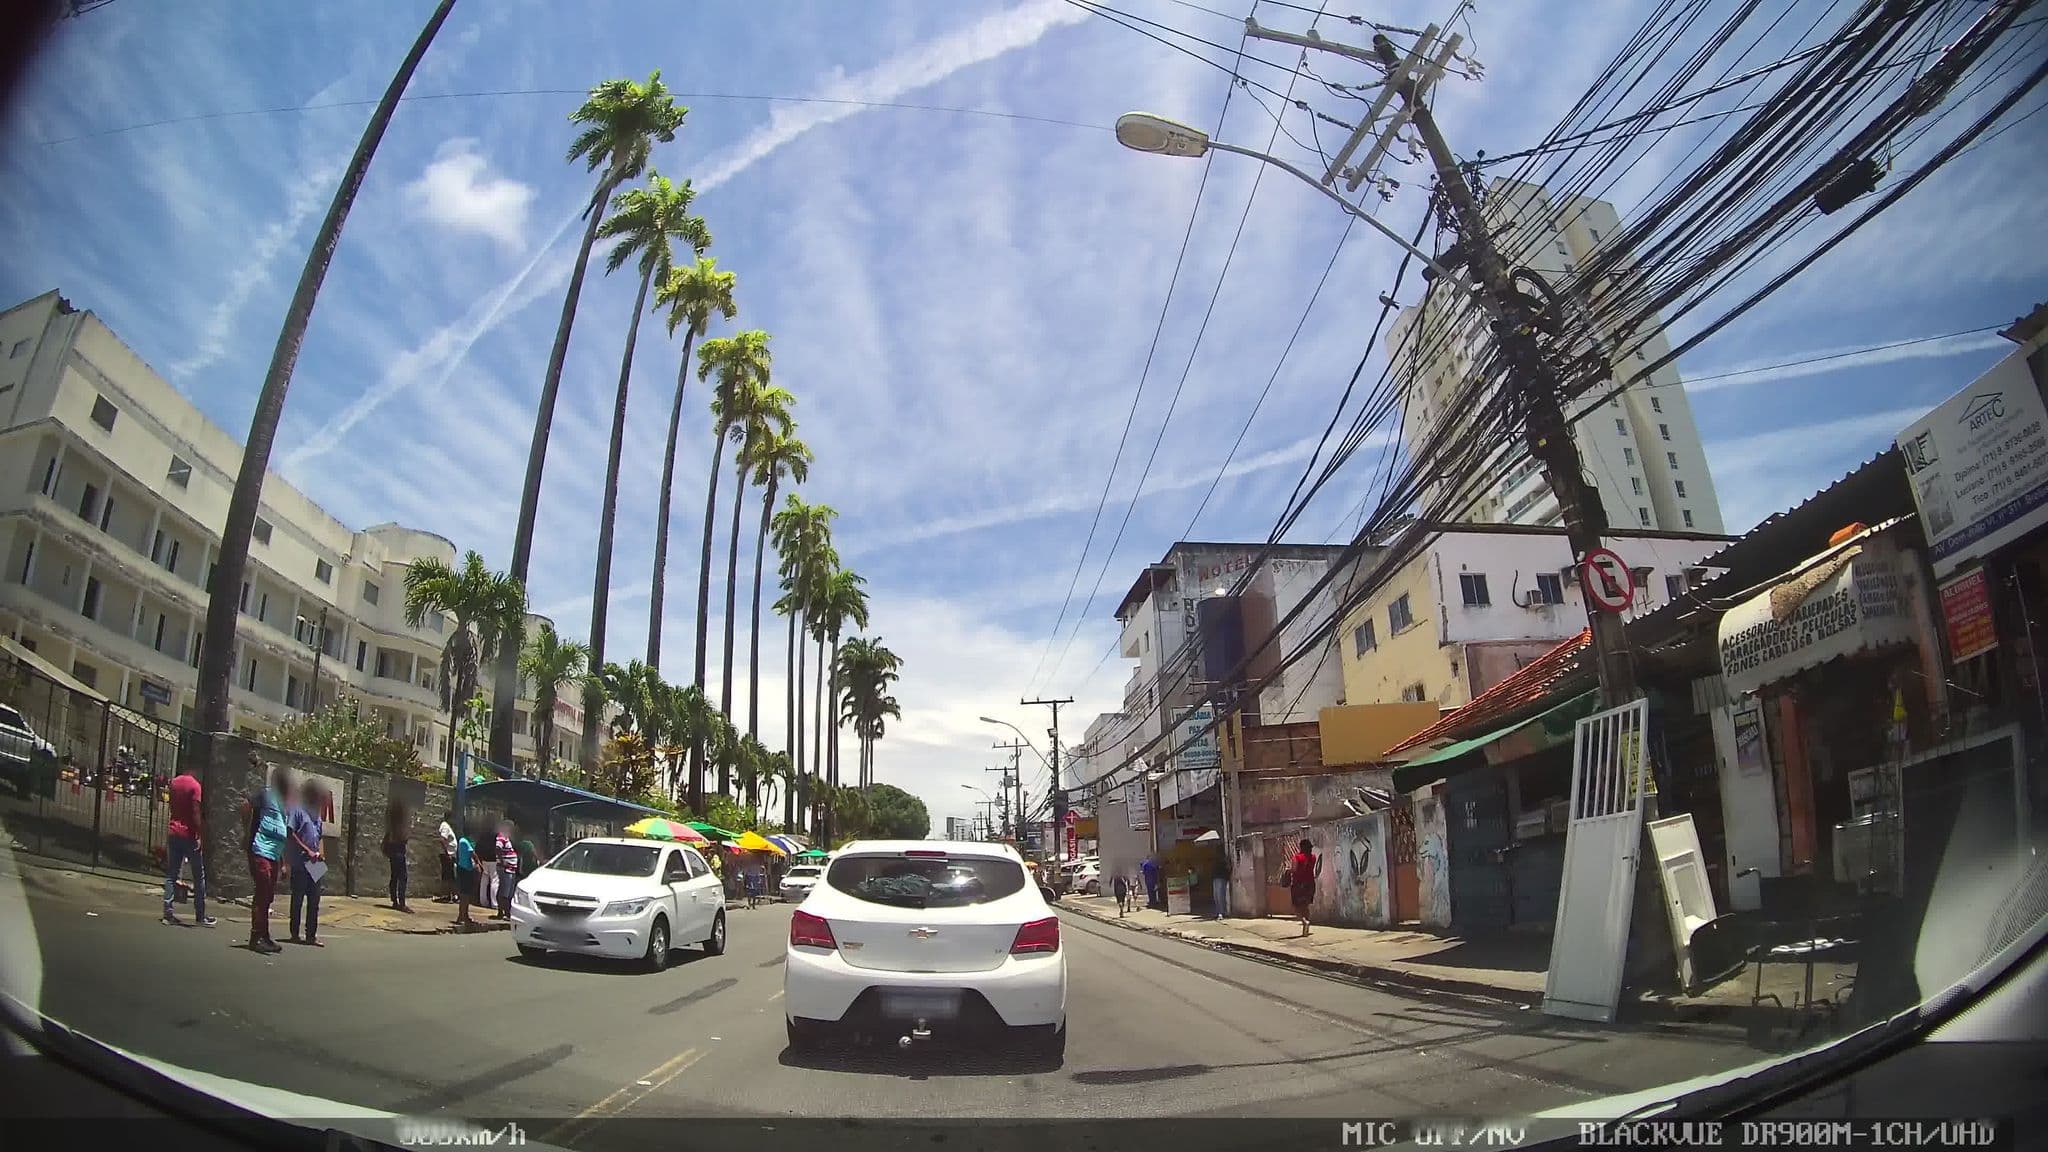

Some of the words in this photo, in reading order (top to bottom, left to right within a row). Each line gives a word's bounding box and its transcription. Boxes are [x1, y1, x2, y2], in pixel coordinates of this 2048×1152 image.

[1970, 399, 2005, 432] ARTEC
[1723, 624, 1798, 668] CARREGADORES
[1727, 653, 1760, 678] FONES
